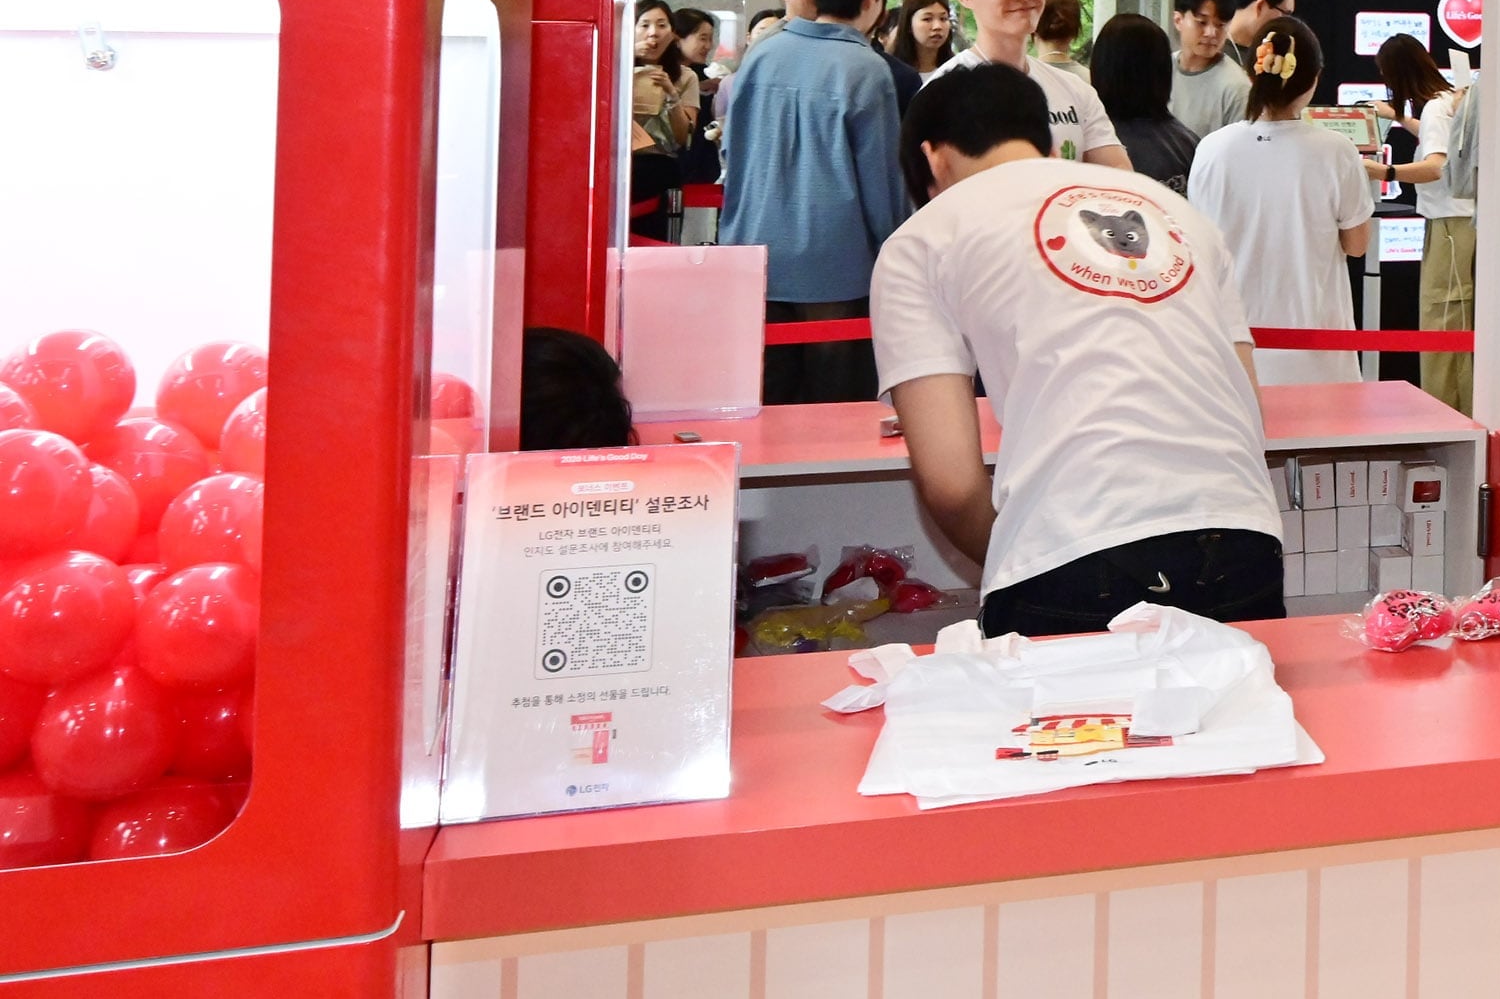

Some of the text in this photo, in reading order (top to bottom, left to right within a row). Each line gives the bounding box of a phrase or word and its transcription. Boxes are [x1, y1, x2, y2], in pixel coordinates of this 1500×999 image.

[1049, 105, 1079, 126] ood
[1070, 262, 1111, 285] when
[1137, 279, 1158, 292] Do
[1159, 254, 1185, 283] Good
[645, 494, 710, 514] 설문조사
[539, 524, 661, 541] LG전자 브랜드 아이덴티티
[524, 545, 554, 558] 인지도
[559, 542, 609, 556] 설문조사에
[511, 695, 541, 708] 추첨을
[544, 694, 564, 706] 통해
[567, 691, 597, 703] 소정의
[599, 689, 627, 702] 선물을
